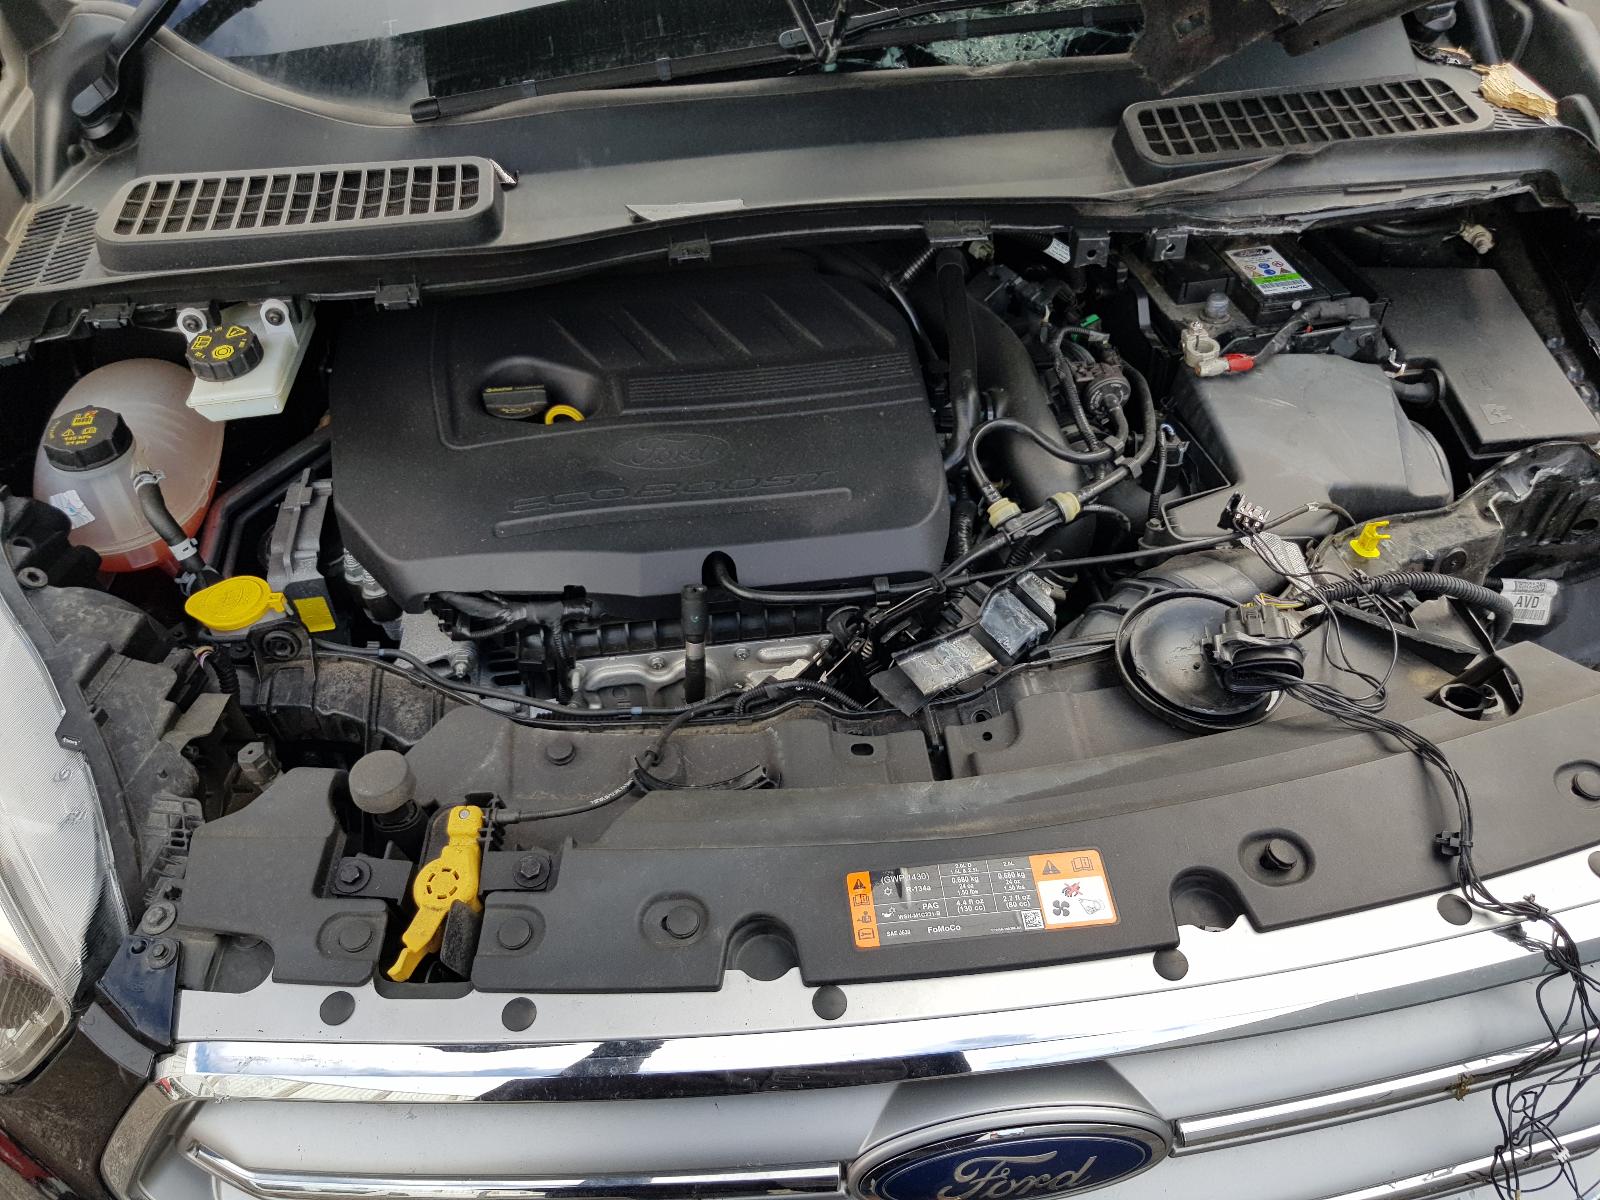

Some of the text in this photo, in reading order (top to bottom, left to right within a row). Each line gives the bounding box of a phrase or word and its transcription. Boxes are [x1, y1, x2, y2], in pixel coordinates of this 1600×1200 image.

[1513, 595, 1540, 608] AVD
[905, 884, 931, 893] R-134a
[922, 902, 939, 910] PAG
[957, 903, 985, 913] (130 cc)
[1019, 900, 1030, 908] cc)
[927, 924, 962, 934] FoMoCo
[937, 1150, 1098, 1200] Ford
